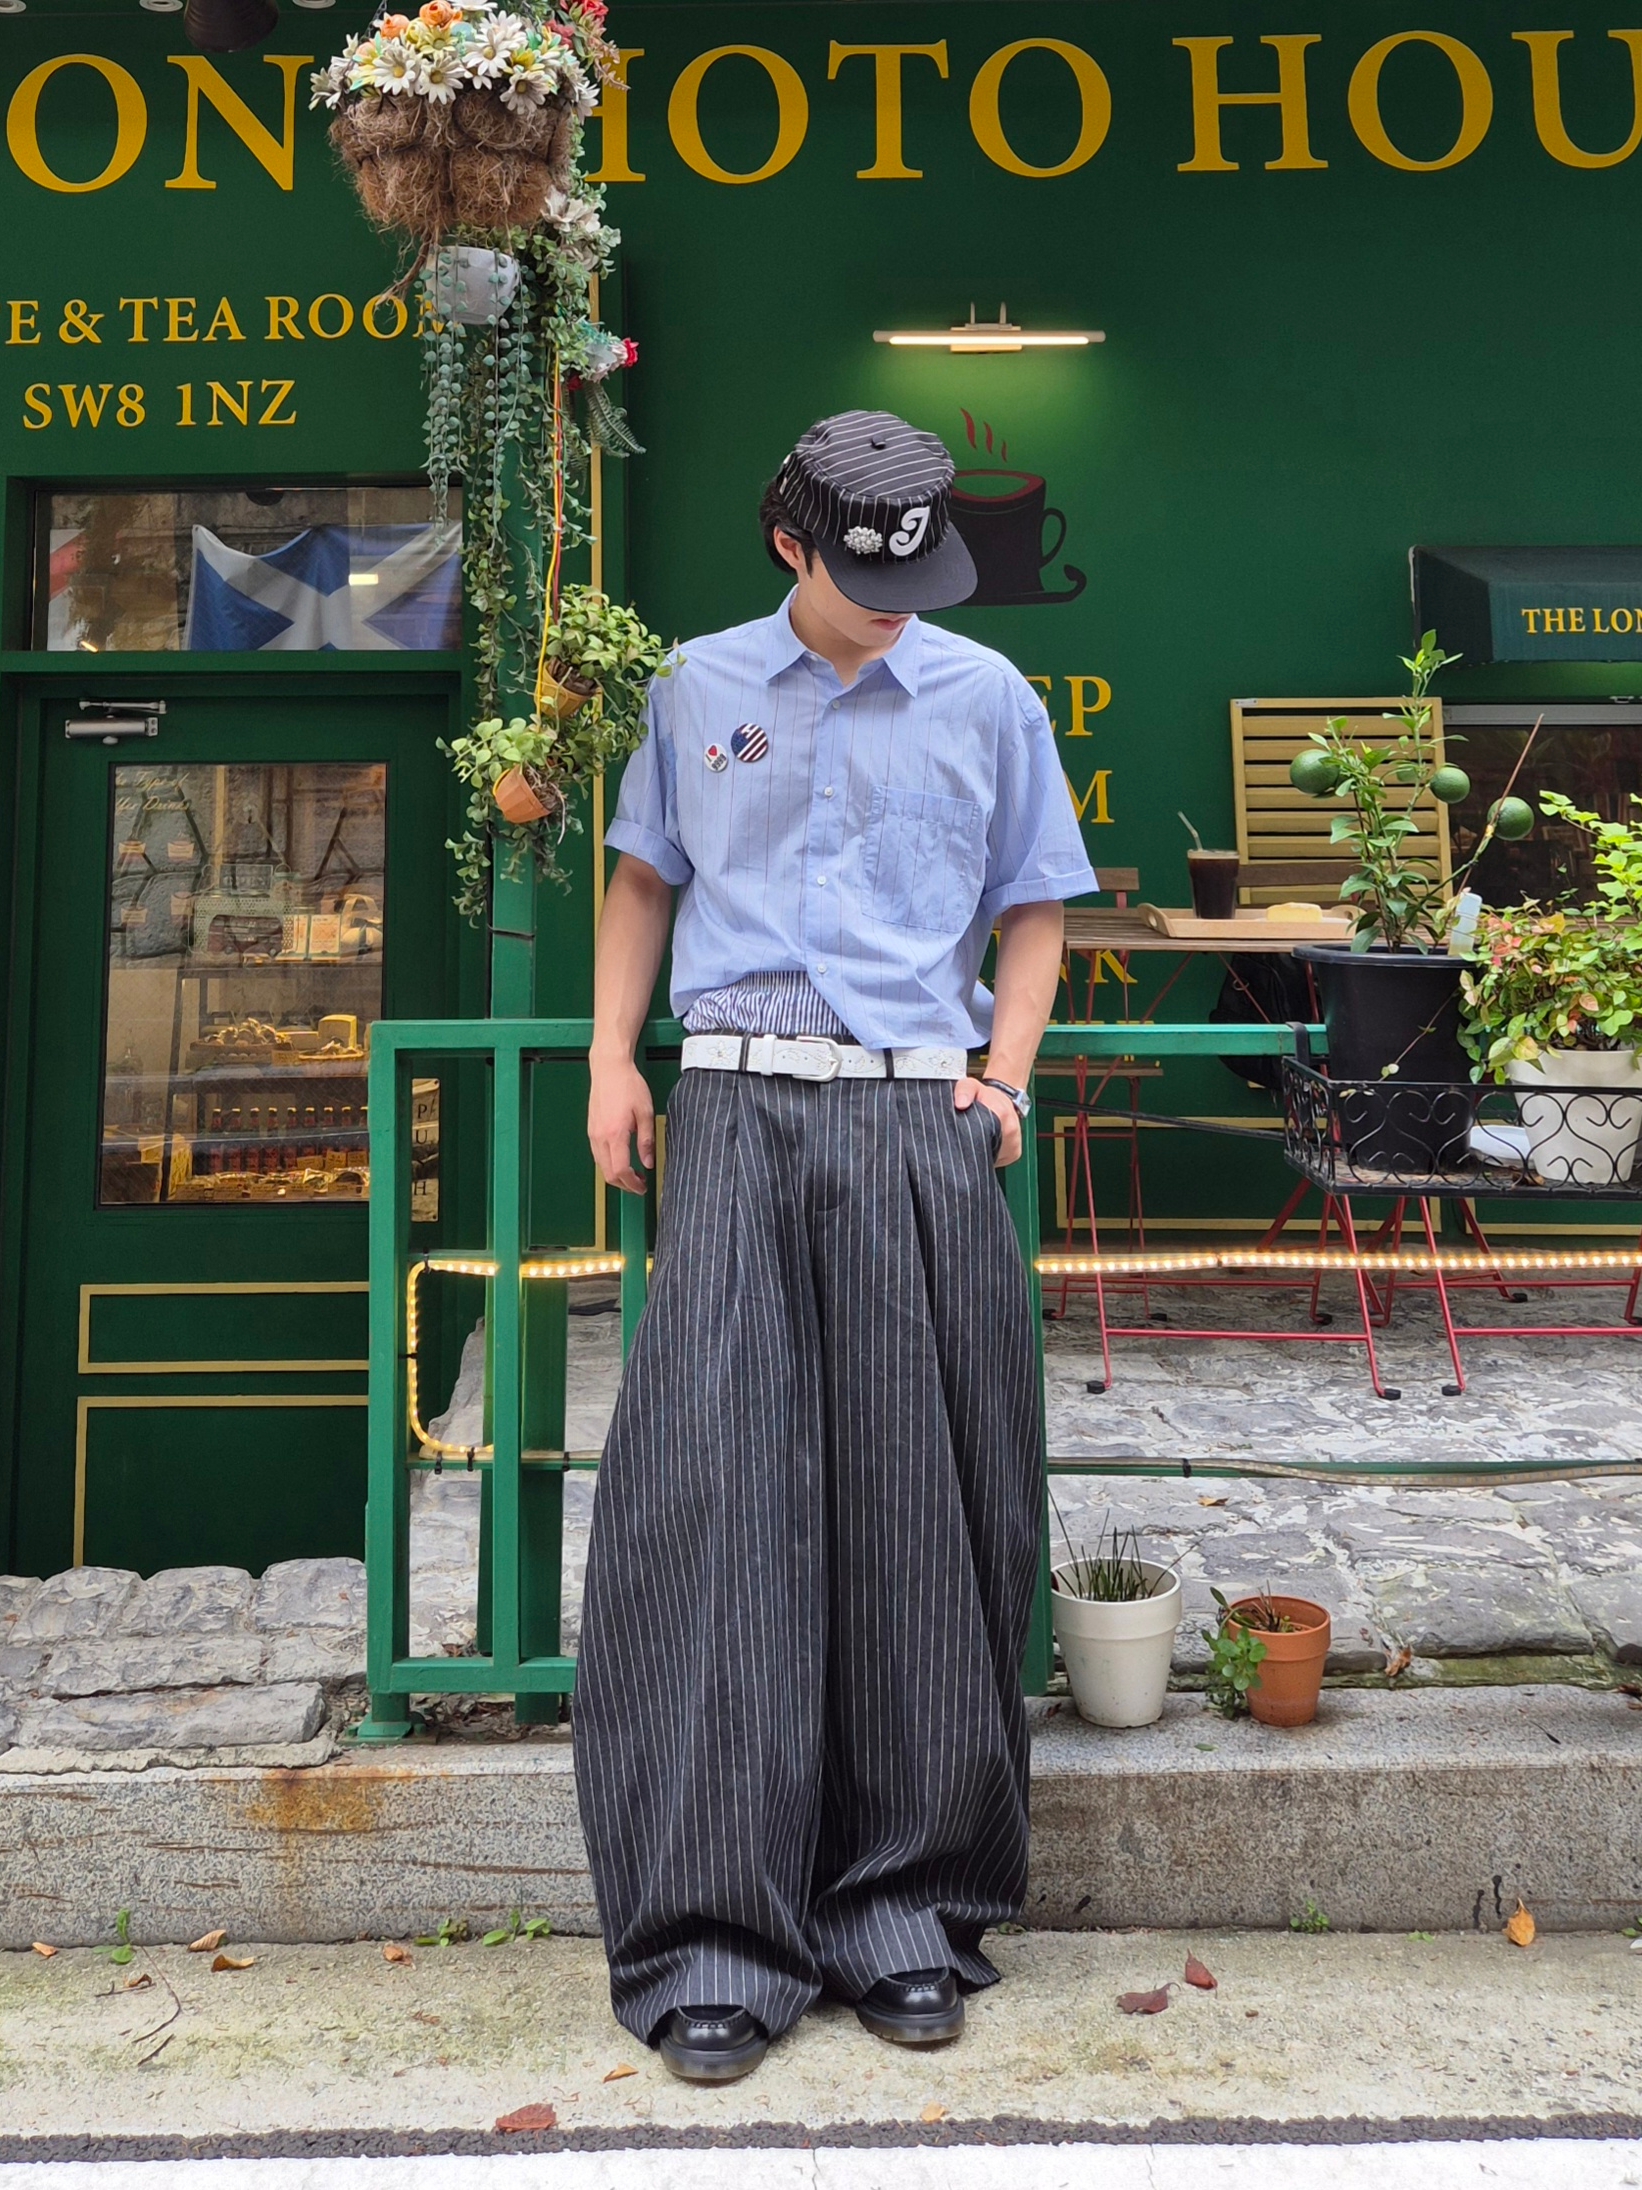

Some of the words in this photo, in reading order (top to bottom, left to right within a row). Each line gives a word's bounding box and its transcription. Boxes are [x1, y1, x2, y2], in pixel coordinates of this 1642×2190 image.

[1172, 29, 1642, 172] HOU
[58, 299, 104, 345] &
[118, 296, 246, 343] TEA
[22, 383, 146, 430] SW8
[176, 379, 297, 426] 1NZ
[1521, 607, 1586, 634] THE
[413, 1102, 428, 1196] PUH
